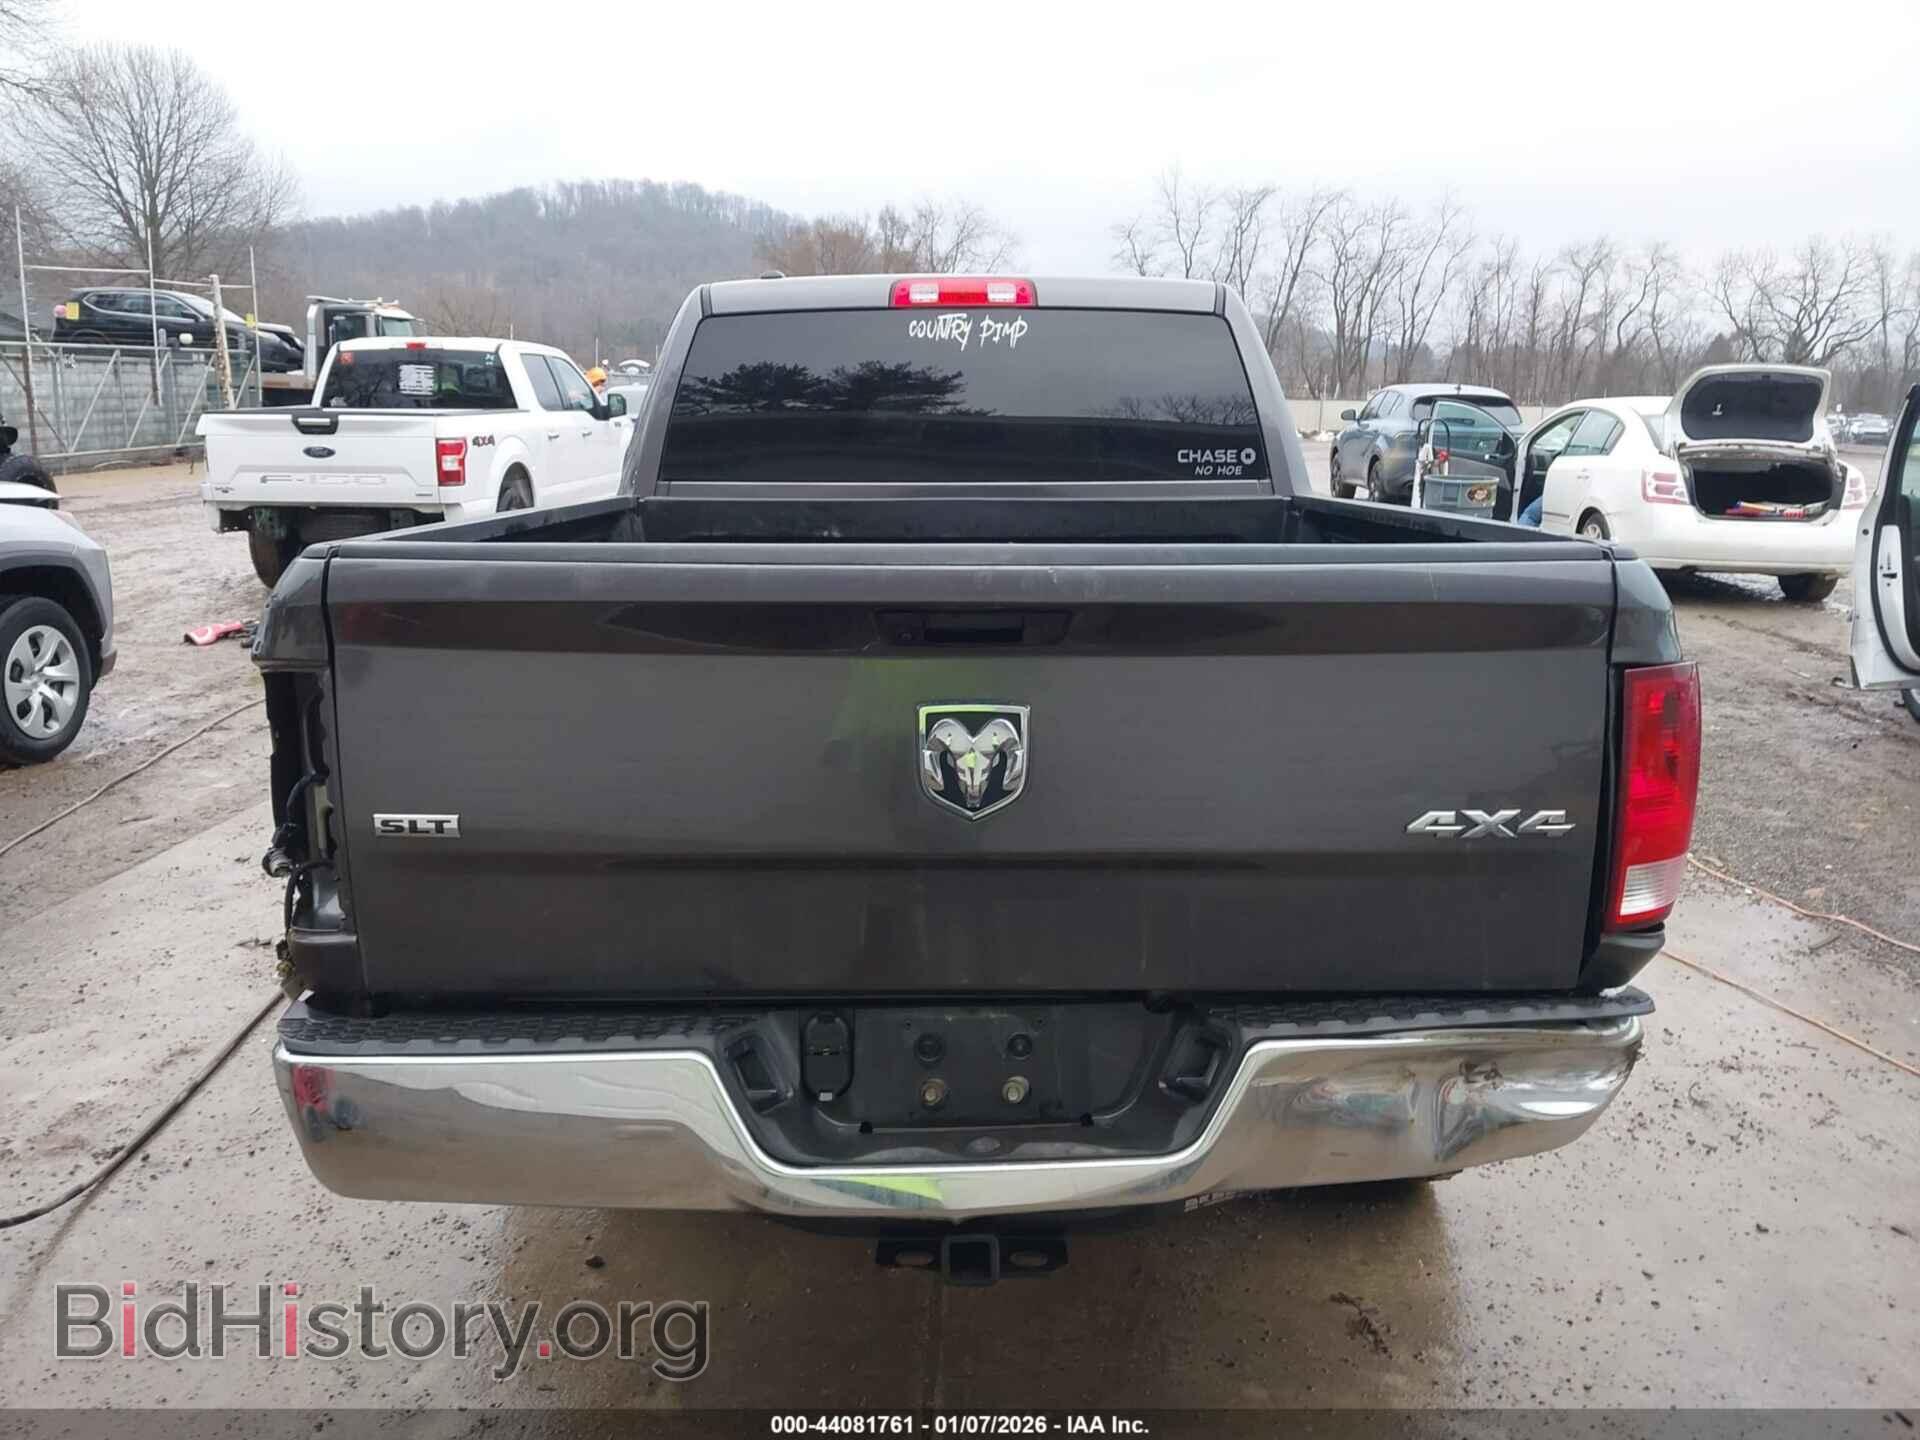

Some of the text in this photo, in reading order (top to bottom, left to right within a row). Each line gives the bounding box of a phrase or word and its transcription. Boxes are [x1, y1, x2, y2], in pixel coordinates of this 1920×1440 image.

[909, 313, 1028, 351] COUNTRY PIMP
[1177, 449, 1238, 463] CHASE
[1194, 465, 1242, 476] NO HOE
[380, 820, 451, 834] SLT
